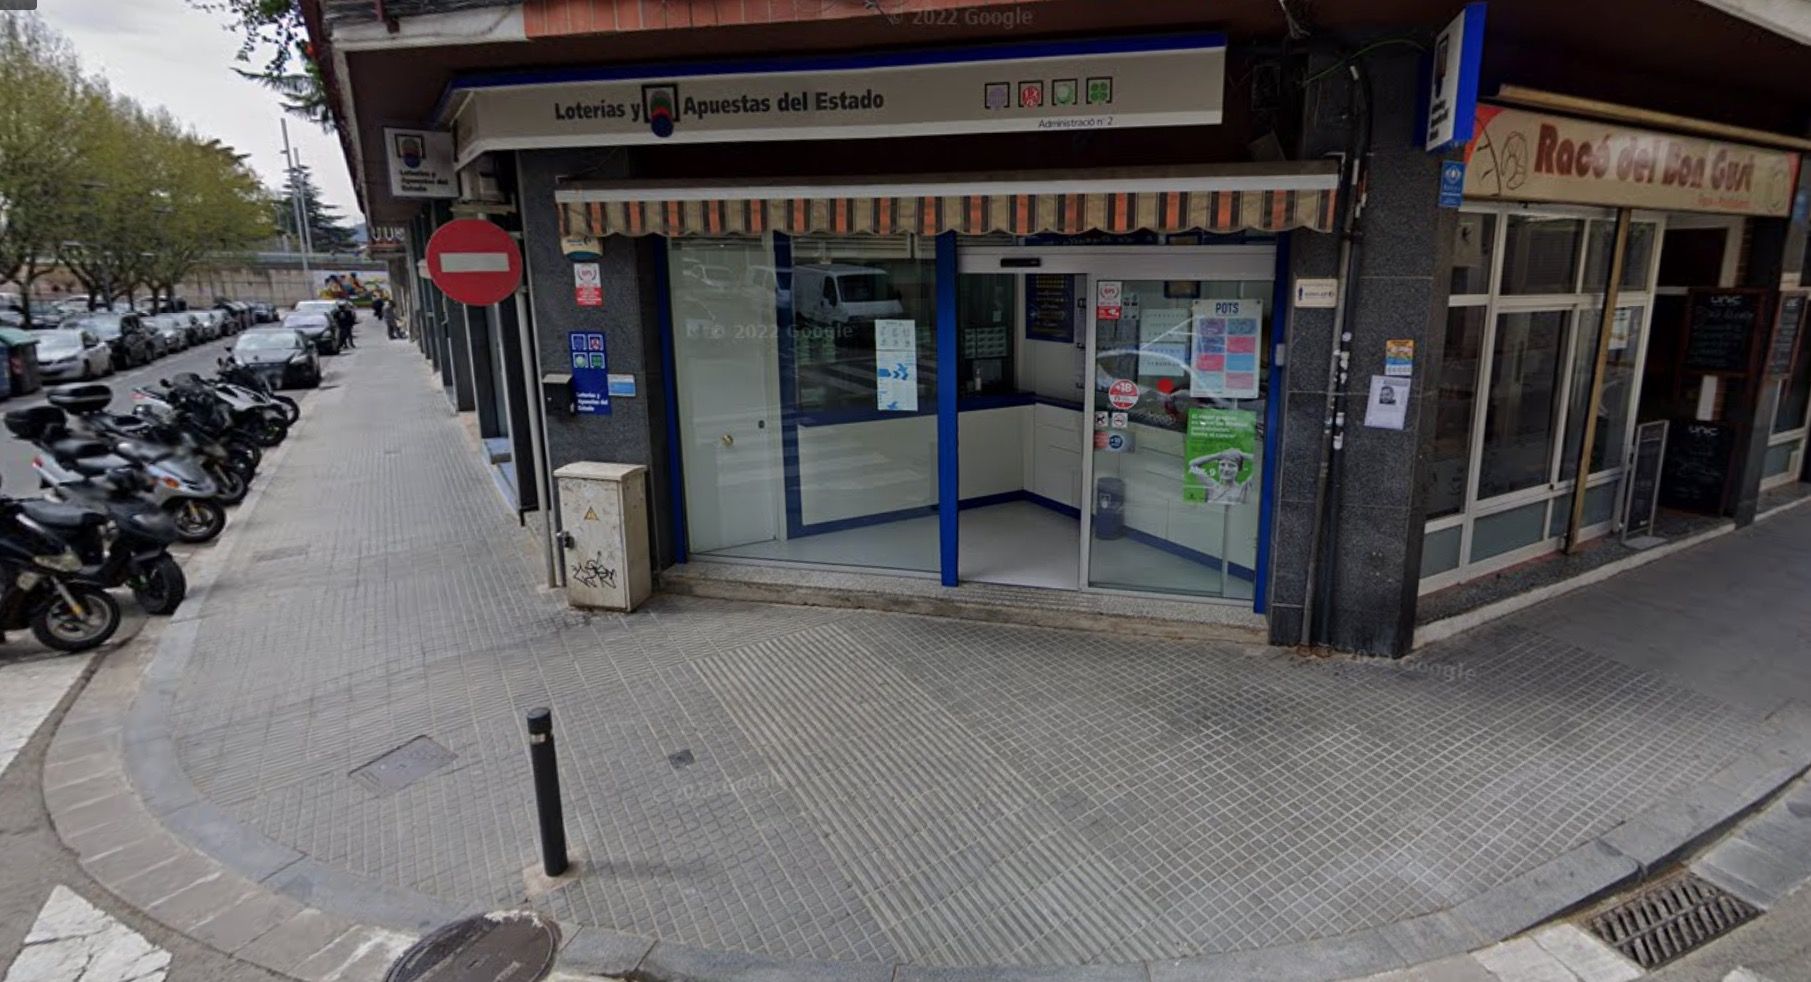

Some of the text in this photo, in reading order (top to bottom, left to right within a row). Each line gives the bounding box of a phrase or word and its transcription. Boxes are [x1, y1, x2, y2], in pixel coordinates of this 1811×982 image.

[630, 102, 641, 122] y
[683, 96, 771, 119] Apuestas
[777, 91, 808, 111] del
[815, 89, 884, 111] Estado
[1038, 117, 1096, 128] Administració
[1107, 116, 1114, 125] 2
[1534, 123, 1613, 180] Racó
[1616, 137, 1658, 184] del
[1215, 301, 1240, 313] POTS
